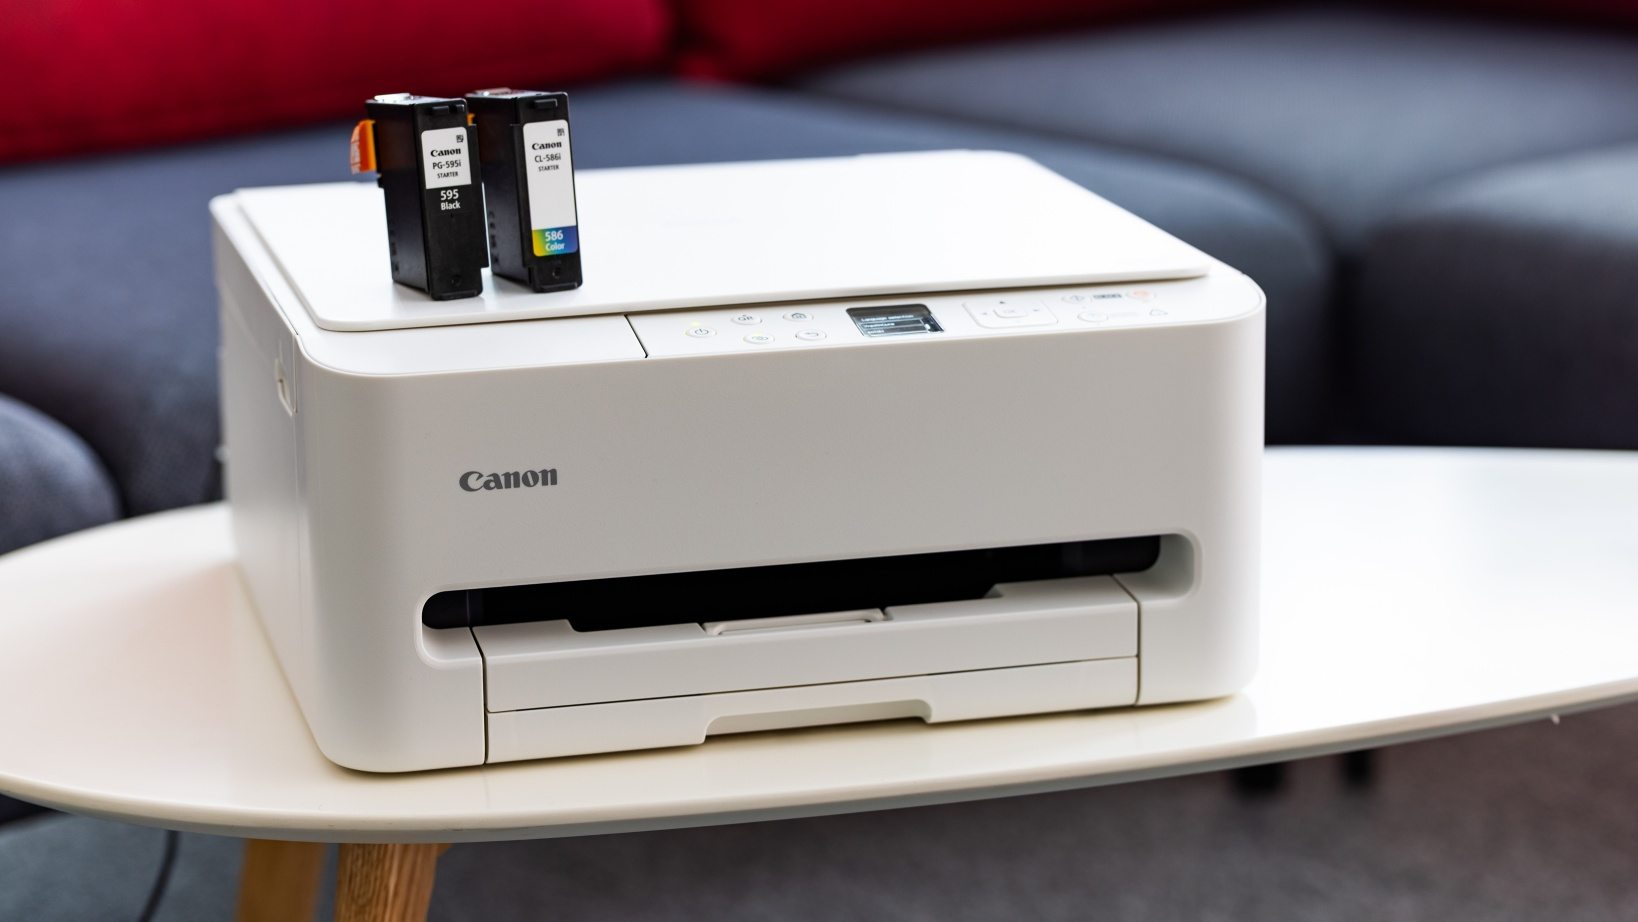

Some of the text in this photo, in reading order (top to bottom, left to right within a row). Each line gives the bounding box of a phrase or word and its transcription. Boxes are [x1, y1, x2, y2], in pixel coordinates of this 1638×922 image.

[532, 141, 562, 150] Canon
[430, 148, 461, 157] Canon
[534, 153, 561, 162] CL-586i
[432, 160, 461, 170] PG-595i
[440, 189, 459, 200] 595
[440, 201, 461, 210] Black
[545, 230, 564, 241] 586
[545, 242, 565, 251] Color
[459, 468, 558, 492] Canon
